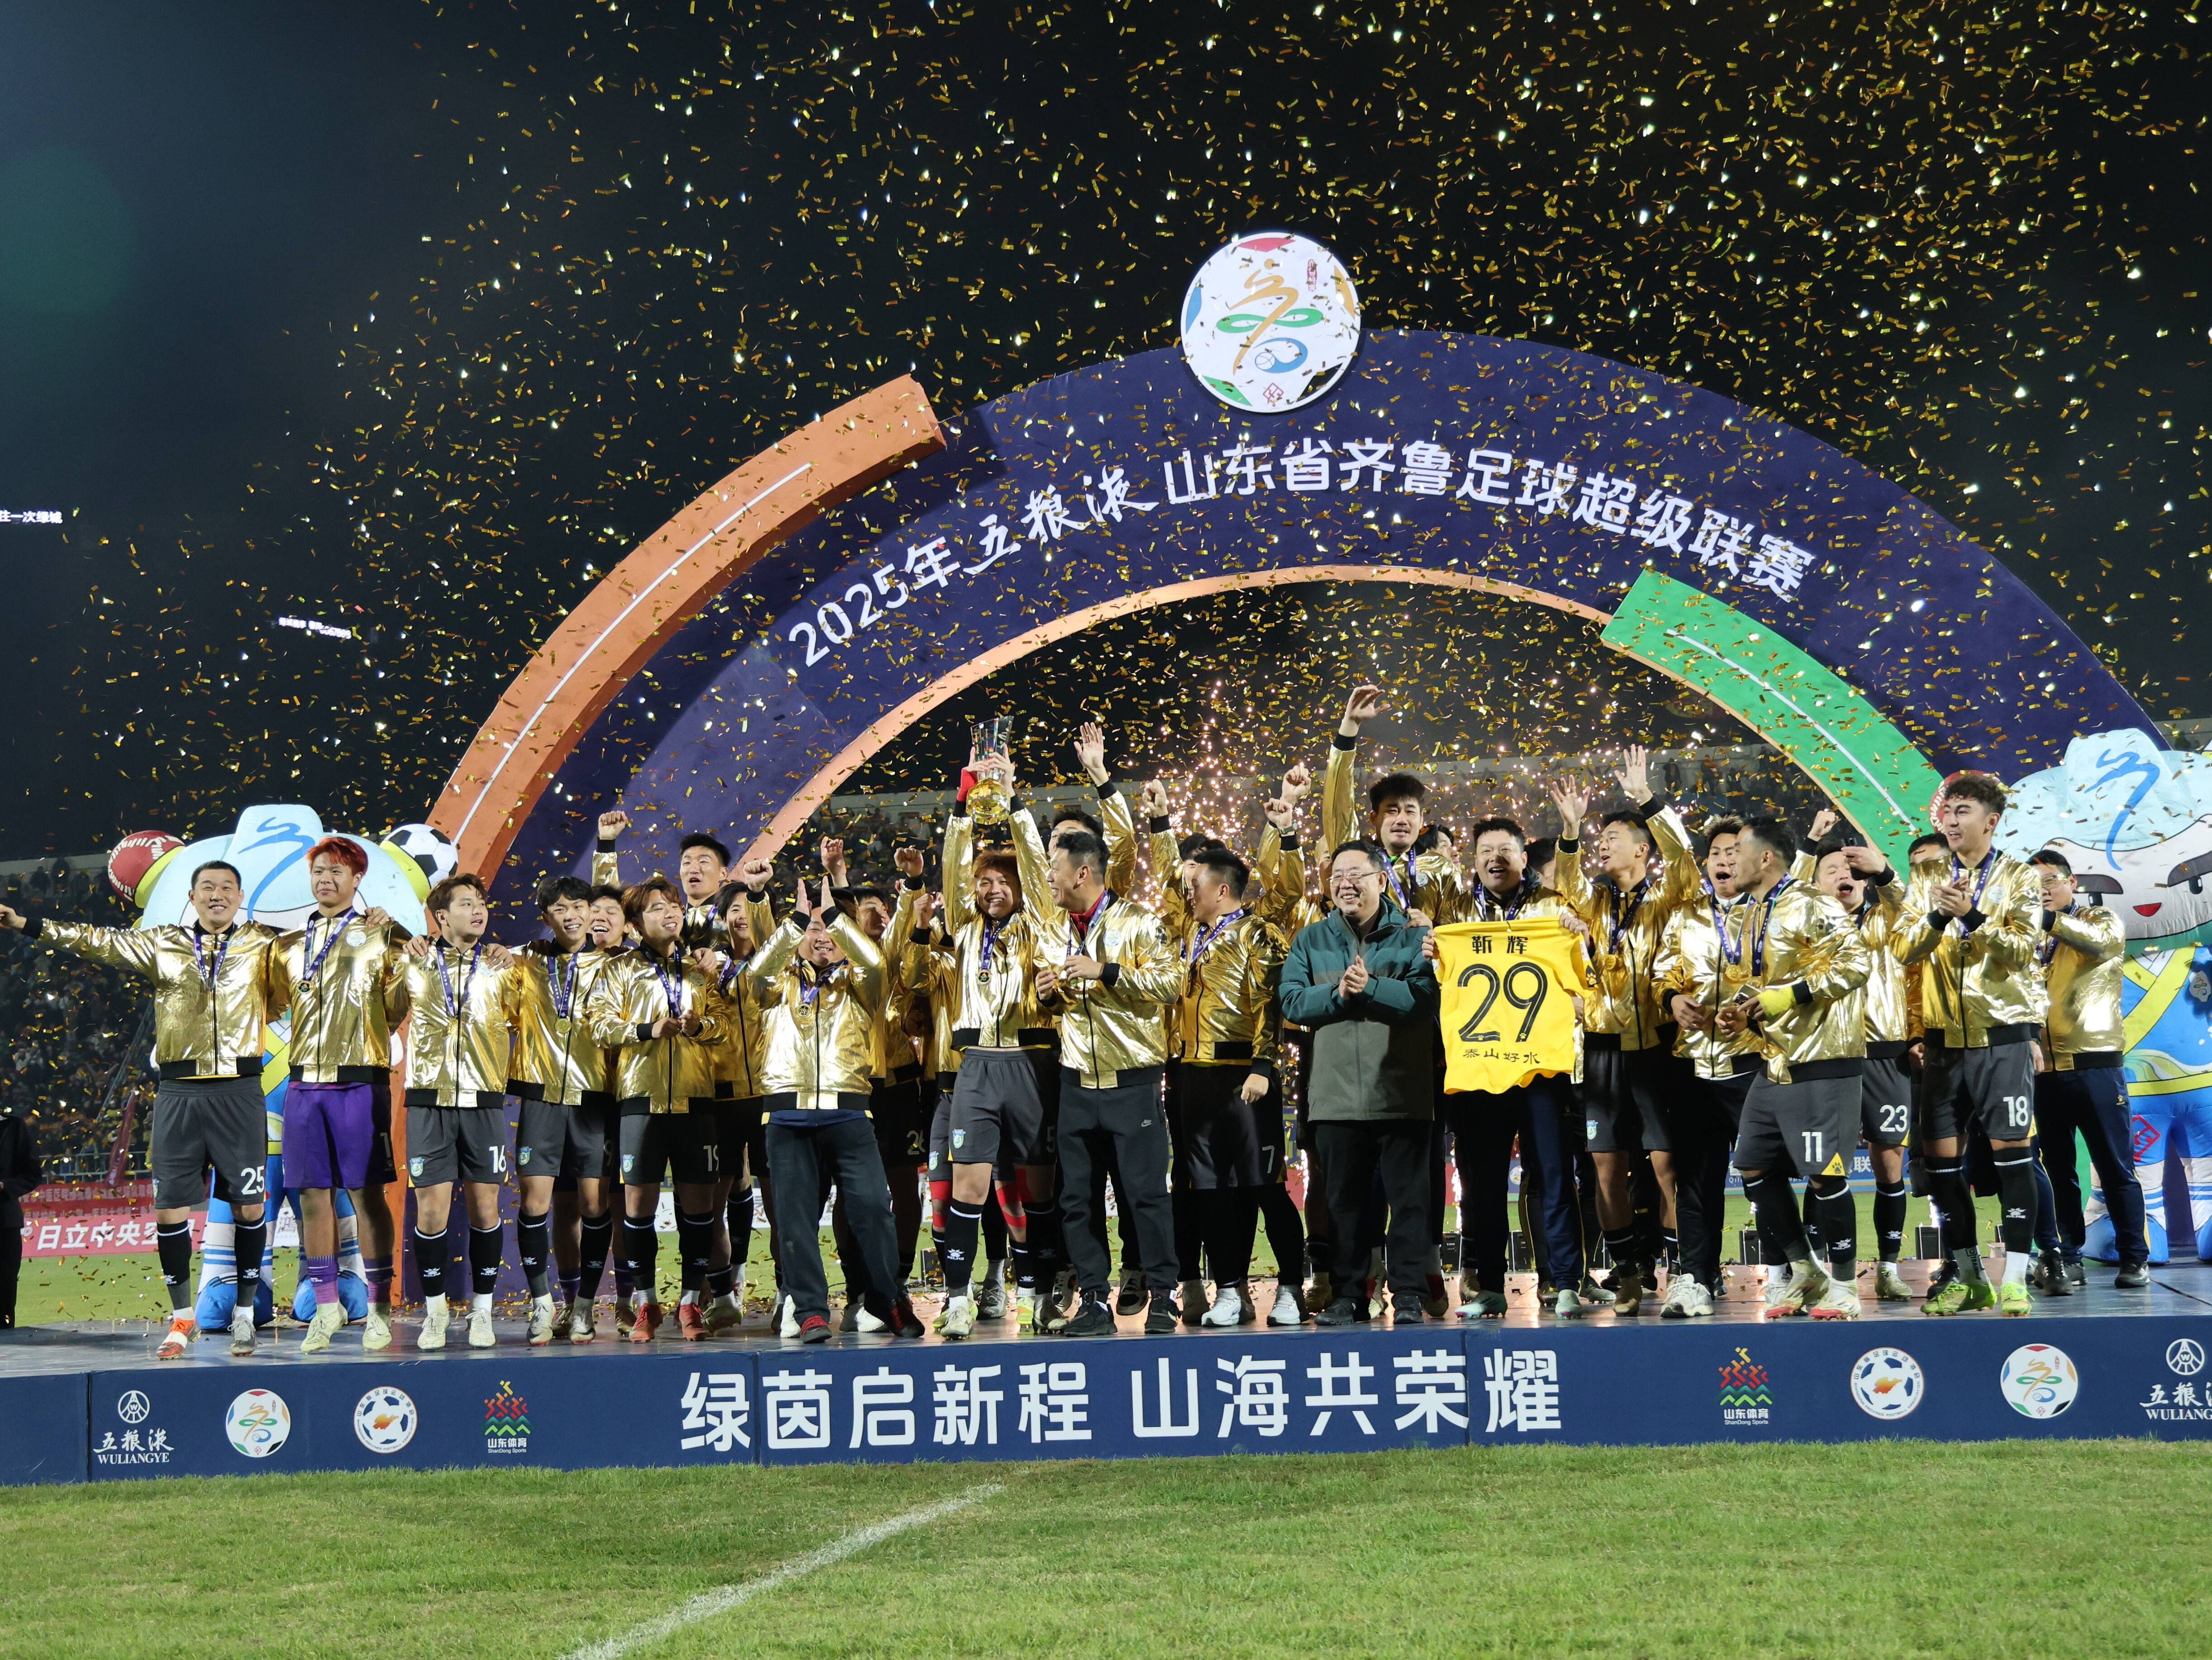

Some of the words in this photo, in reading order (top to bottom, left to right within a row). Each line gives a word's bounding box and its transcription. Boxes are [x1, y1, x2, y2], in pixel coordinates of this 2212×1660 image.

[1457, 962, 1548, 1043] 29
[1463, 1048, 1541, 1065] 泰山好水
[1879, 1105, 1908, 1132] 23
[2003, 1096, 2028, 1127] 18
[489, 1145, 507, 1173] 16
[1262, 1145, 1275, 1173] 7
[1802, 1132, 1822, 1162] 11
[241, 1165, 265, 1195] 25
[680, 1362, 1092, 1451] 绿茵启新程
[1131, 1348, 1562, 1438] 山海共荣耀
[1724, 1408, 1769, 1419] 山东体育
[93, 1427, 175, 1453] 五粮液
[488, 1437, 527, 1448] 山东体育
[97, 1452, 170, 1464] WULIANGYE
